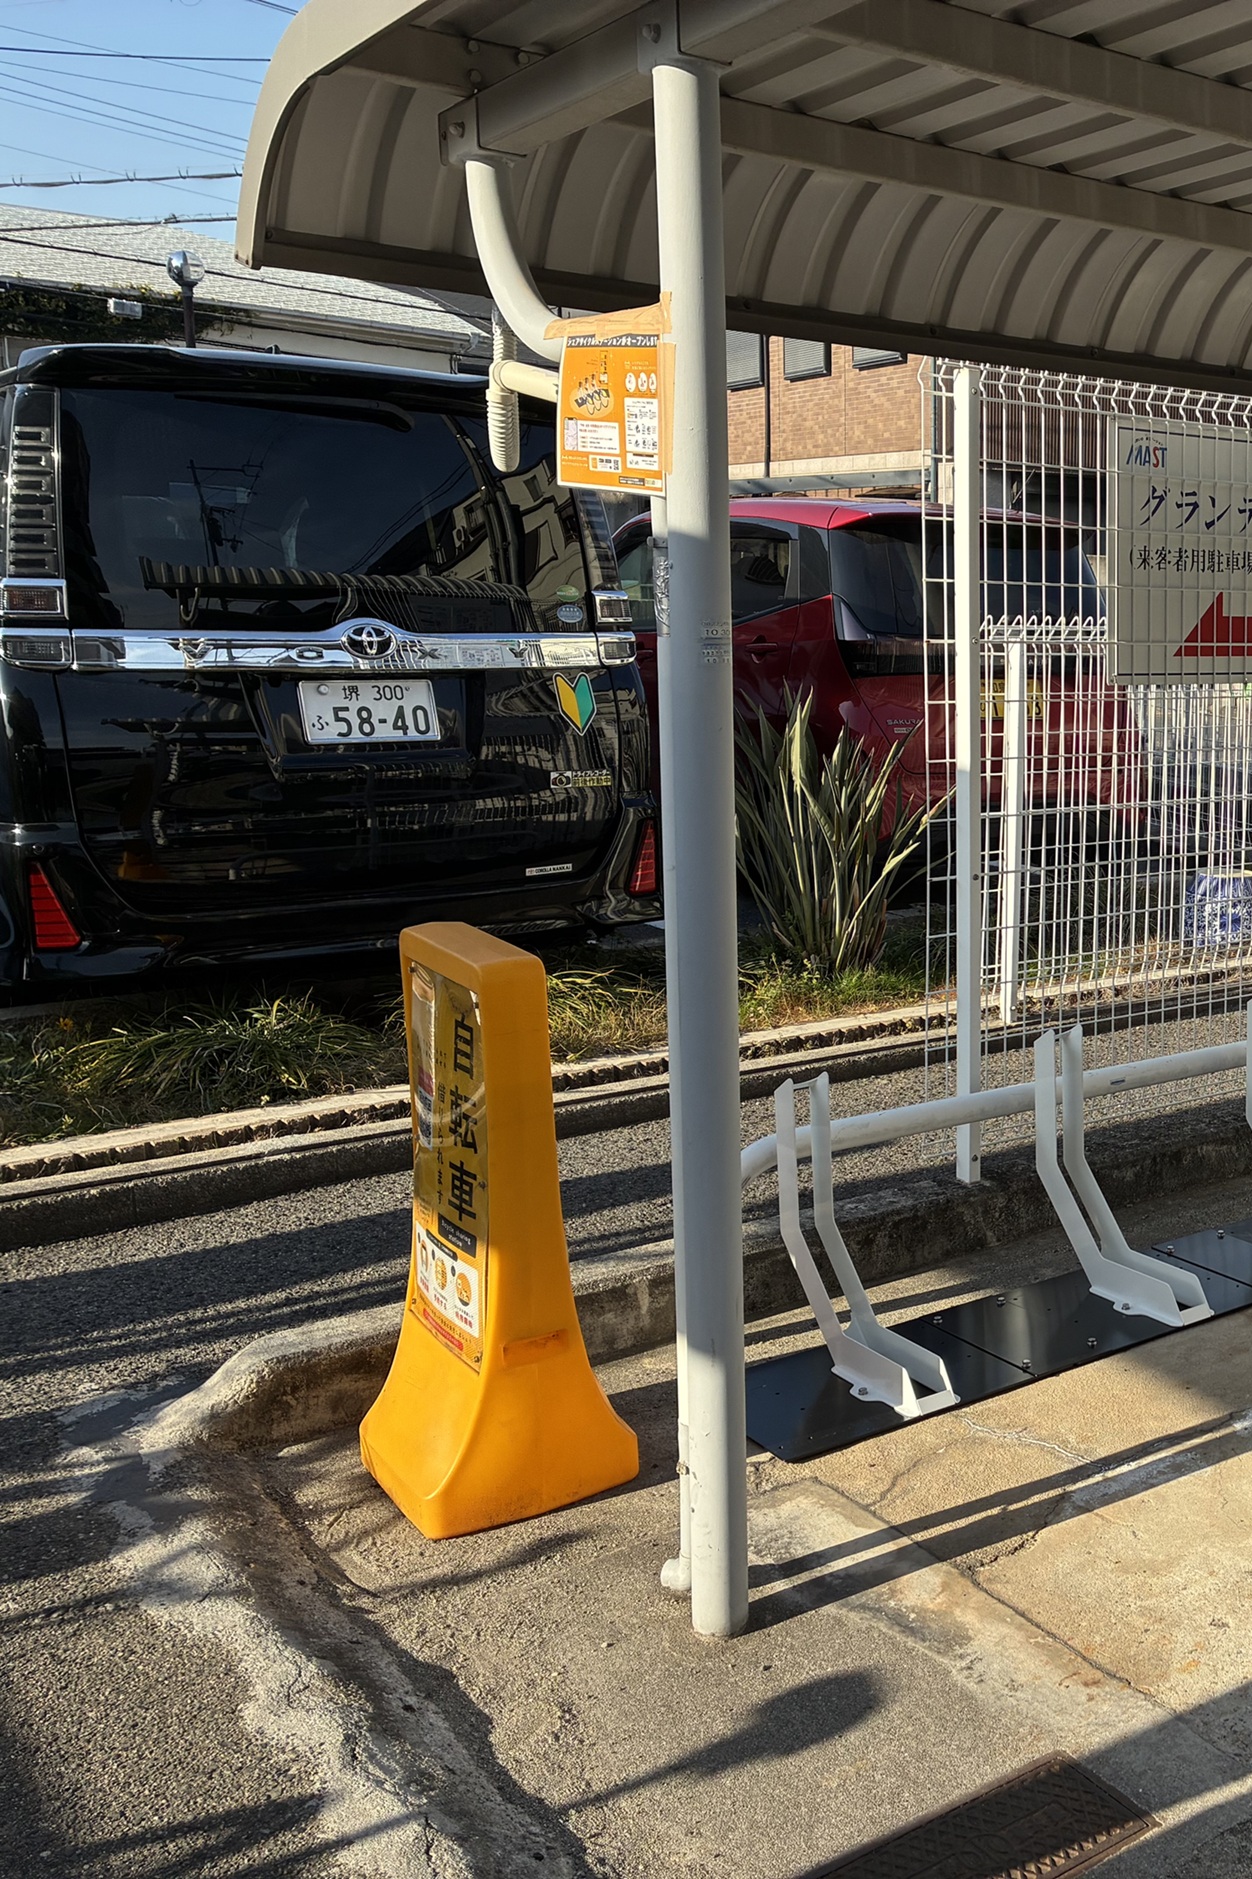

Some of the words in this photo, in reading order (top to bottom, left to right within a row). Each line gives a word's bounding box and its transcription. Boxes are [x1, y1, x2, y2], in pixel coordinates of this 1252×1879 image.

[1126, 444, 1167, 468] MAST
[342, 685, 360, 701] 堺
[371, 685, 405, 701] 300
[311, 714, 330, 731] ふ
[332, 704, 431, 738] 58-40
[887, 718, 920, 726] SAKURA
[448, 1012, 478, 1222] 自転車
